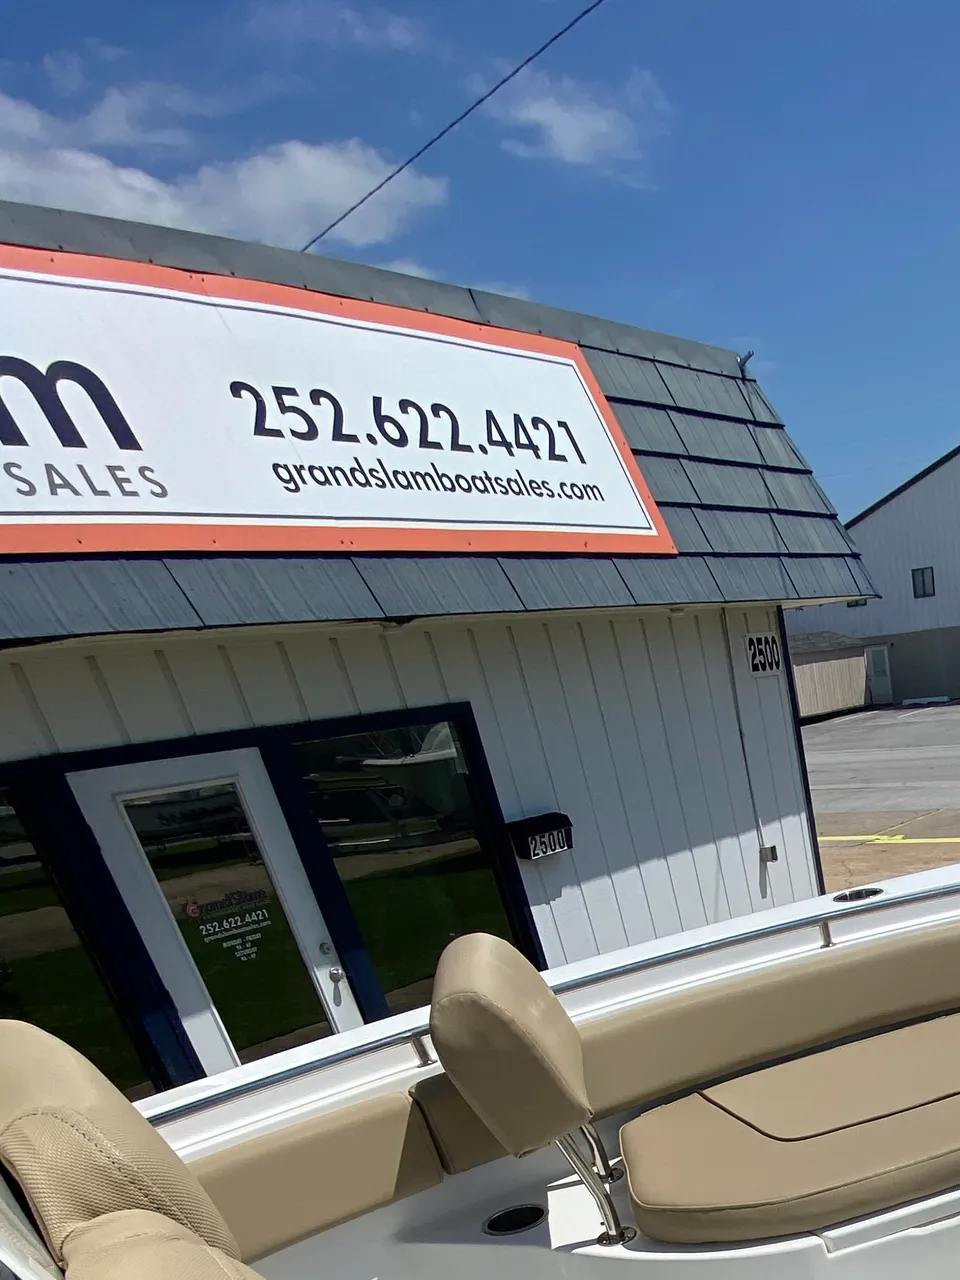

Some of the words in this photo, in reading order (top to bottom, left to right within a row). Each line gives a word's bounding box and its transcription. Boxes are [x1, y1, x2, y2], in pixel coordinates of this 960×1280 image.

[230, 380, 588, 465] 252.622.4421
[3, 461, 168, 498] SALES
[271, 456, 606, 503] grandslamboatsales.com
[748, 635, 781, 673] 2500
[529, 828, 567, 859] 2500
[199, 909, 269, 935] 252.622.4421
